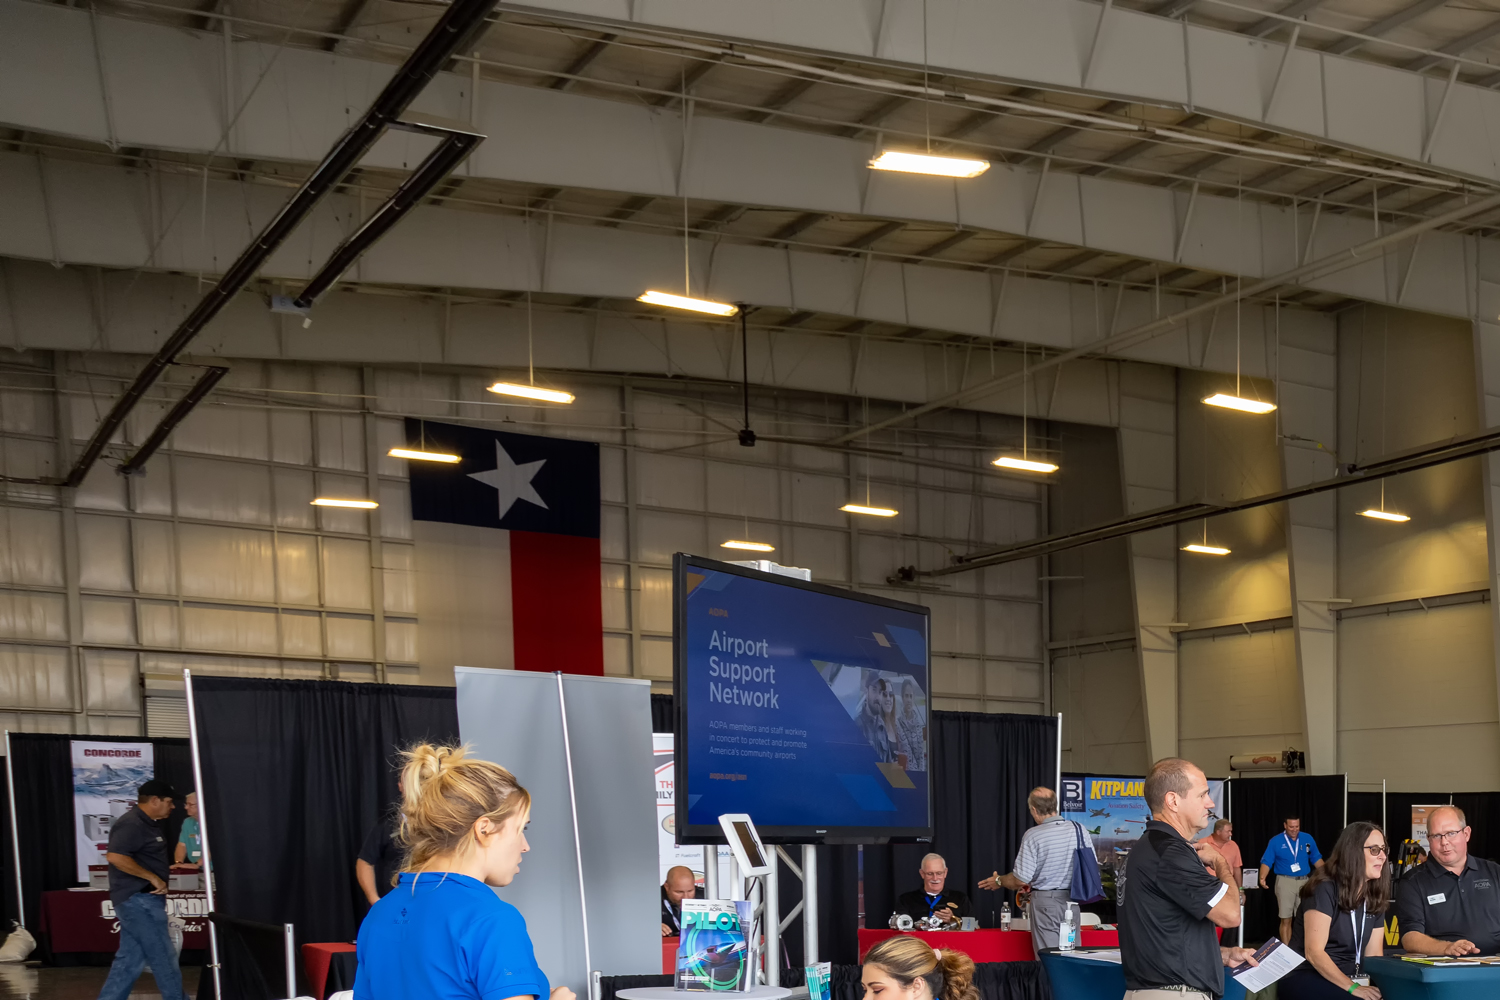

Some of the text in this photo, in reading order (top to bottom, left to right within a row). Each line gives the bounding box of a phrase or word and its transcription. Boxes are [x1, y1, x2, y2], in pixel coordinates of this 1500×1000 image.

[708, 608, 728, 618] AOPA
[708, 630, 768, 658] Airport
[709, 656, 776, 684] Support
[710, 682, 780, 709] Network
[709, 720, 728, 729] AOPA
[729, 724, 757, 732] members
[716, 735, 740, 743] concert
[748, 738, 770, 746] protect
[783, 740, 808, 749] promote
[84, 748, 142, 758] CONCORDE
[709, 746, 796, 760] America's community airports
[1090, 781, 1144, 800] KITPLAN
[681, 911, 741, 932] PILOT
